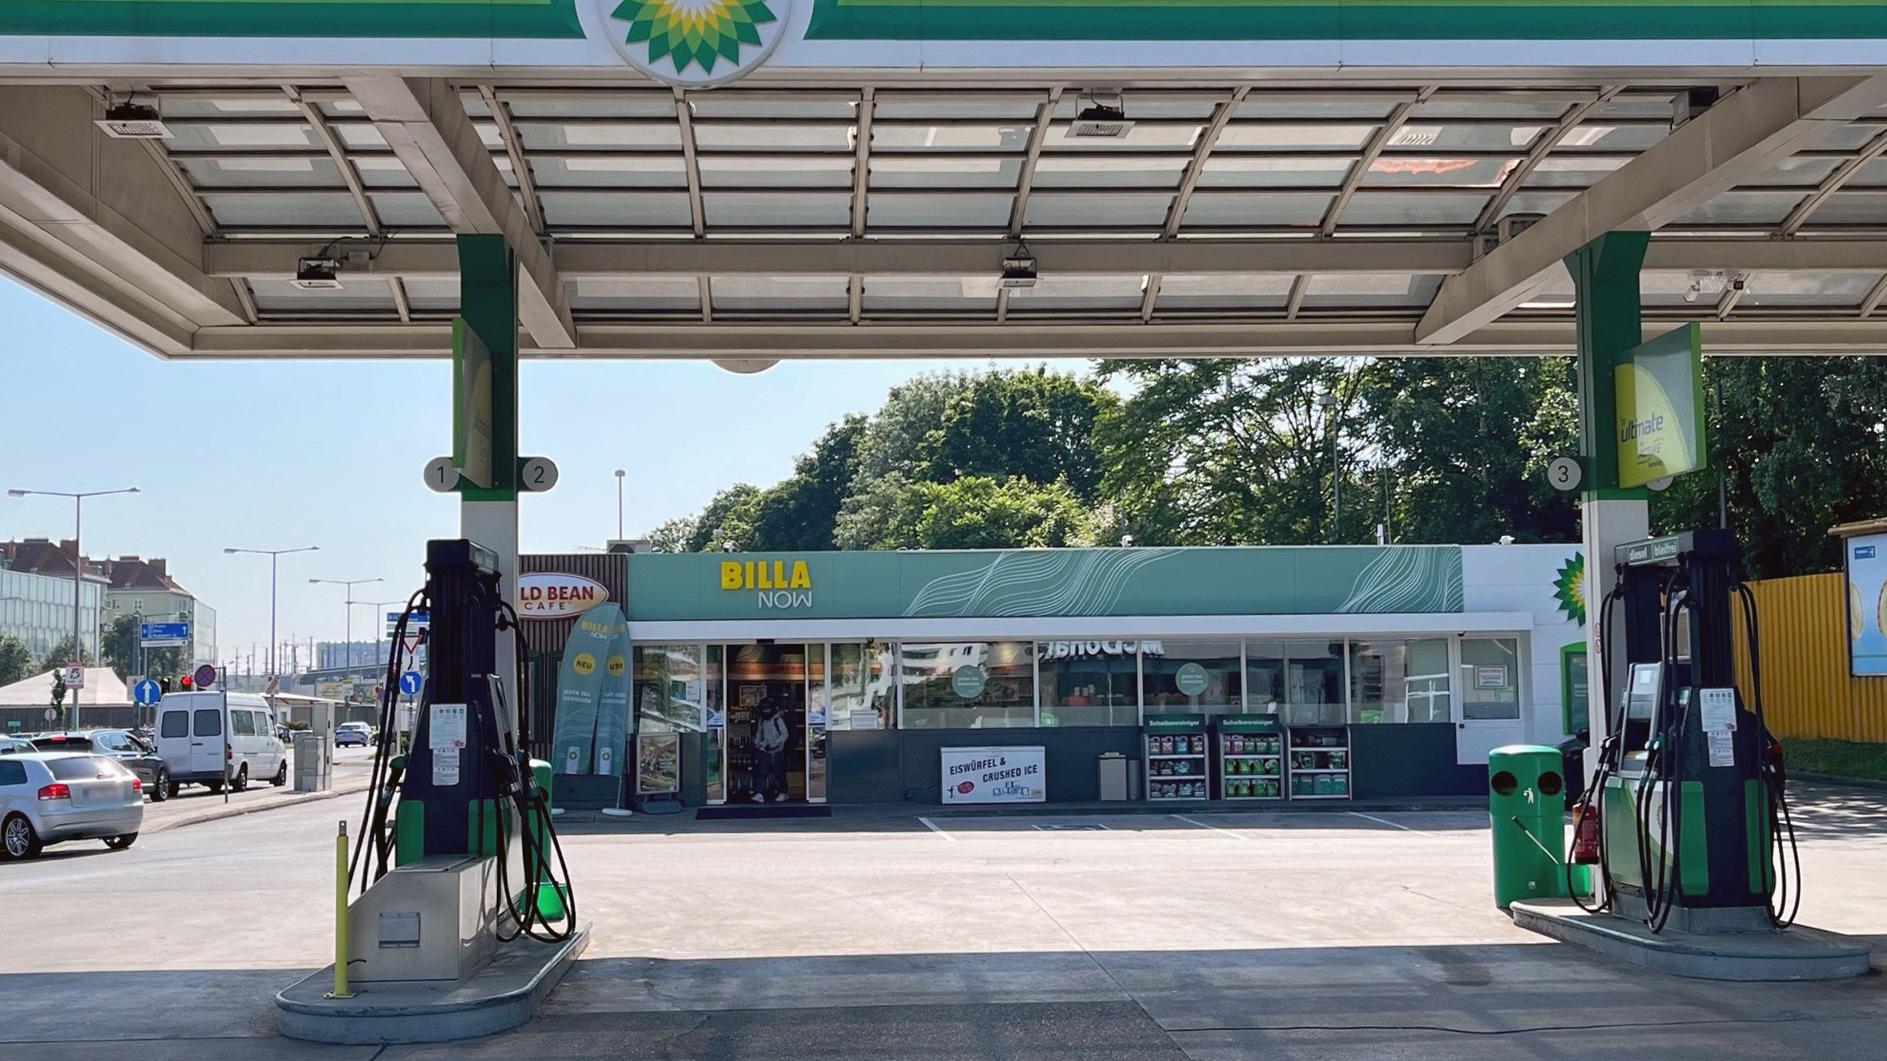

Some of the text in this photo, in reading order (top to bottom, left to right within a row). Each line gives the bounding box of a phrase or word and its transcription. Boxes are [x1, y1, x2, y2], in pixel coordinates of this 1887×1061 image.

[436, 466, 445, 484] 1
[533, 466, 545, 484] 2
[1558, 465, 1569, 483] 3
[720, 560, 812, 590] BILLA
[520, 586, 594, 601] LD BEAN
[758, 591, 813, 609] NOW
[524, 601, 567, 611] CAFE
[1149, 719, 1200, 728] Scheibenreiniger
[1222, 718, 1274, 727] Scheibenreiniger
[949, 757, 1006, 775] EISWÜRFEL &
[982, 764, 1038, 783] CRUSHED ICE
